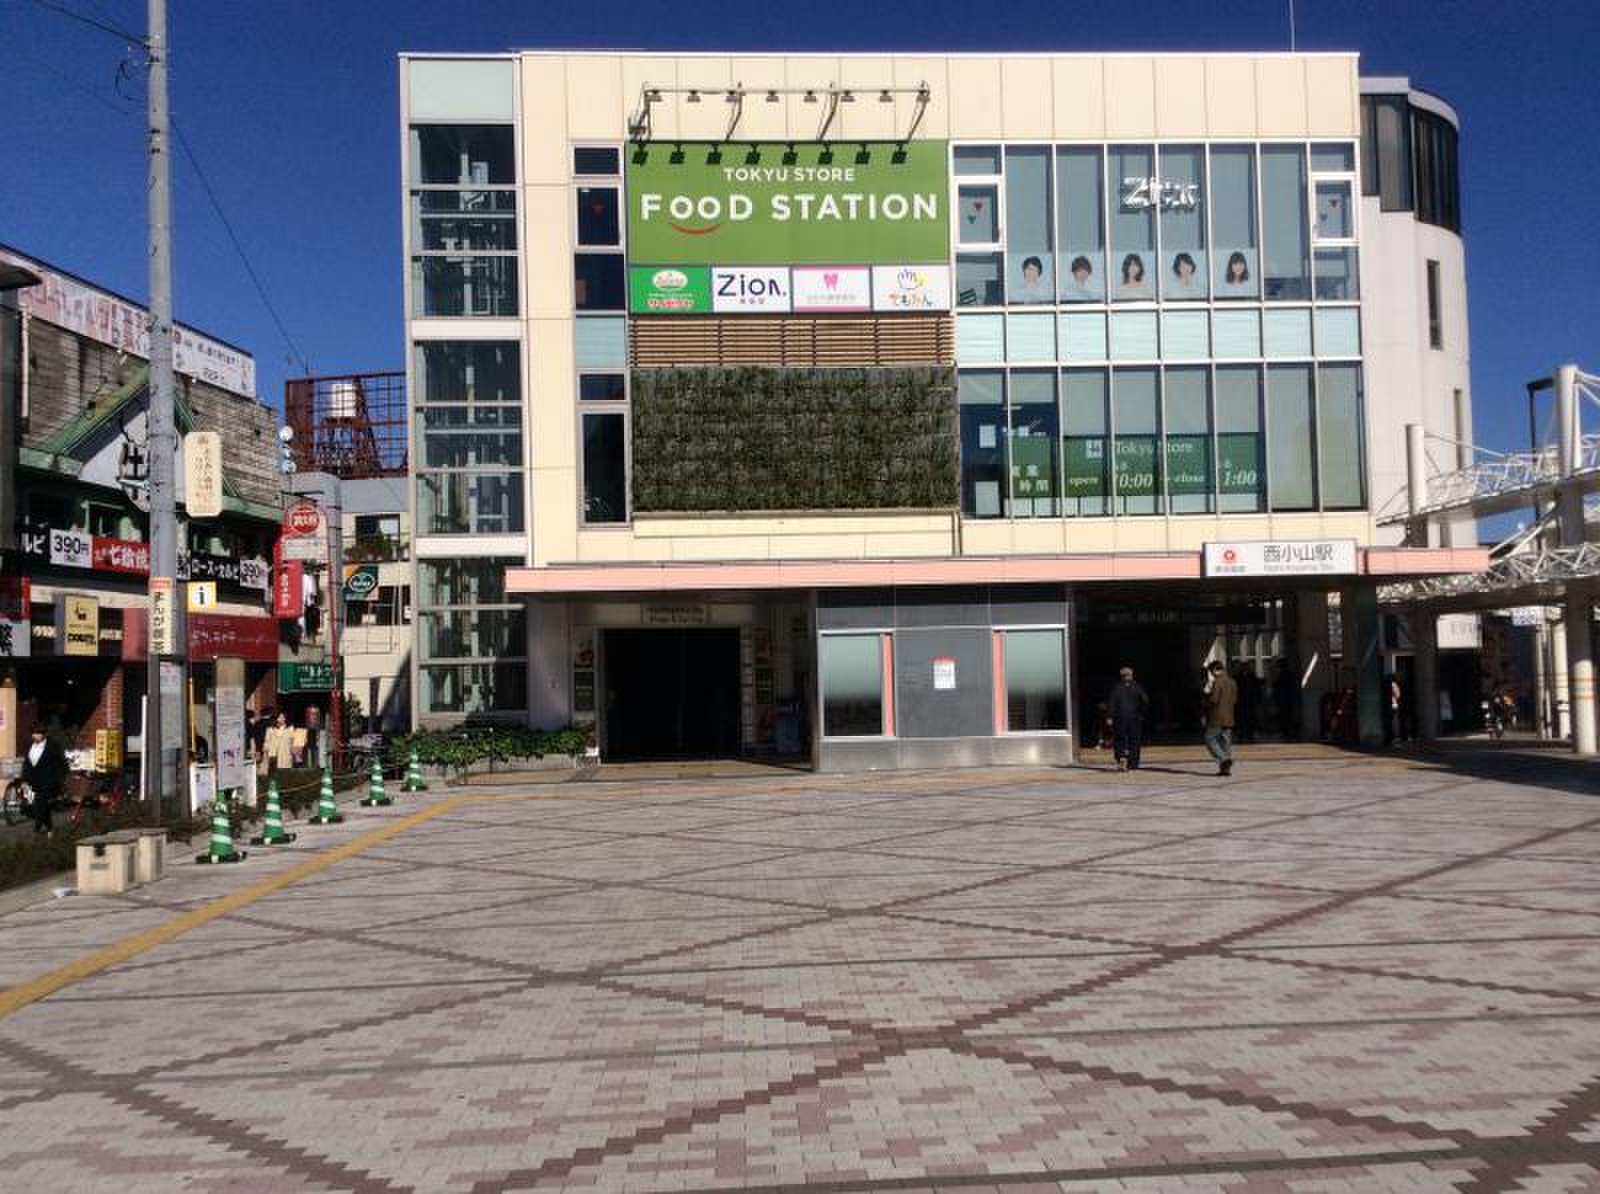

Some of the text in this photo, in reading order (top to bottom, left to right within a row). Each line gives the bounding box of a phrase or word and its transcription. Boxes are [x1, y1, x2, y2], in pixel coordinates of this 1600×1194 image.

[723, 168, 856, 182] TOKYU STORE
[640, 193, 938, 220] FOOD STATION
[1158, 441, 1194, 453] tore
[1263, 543, 1334, 563] 西小山駅
